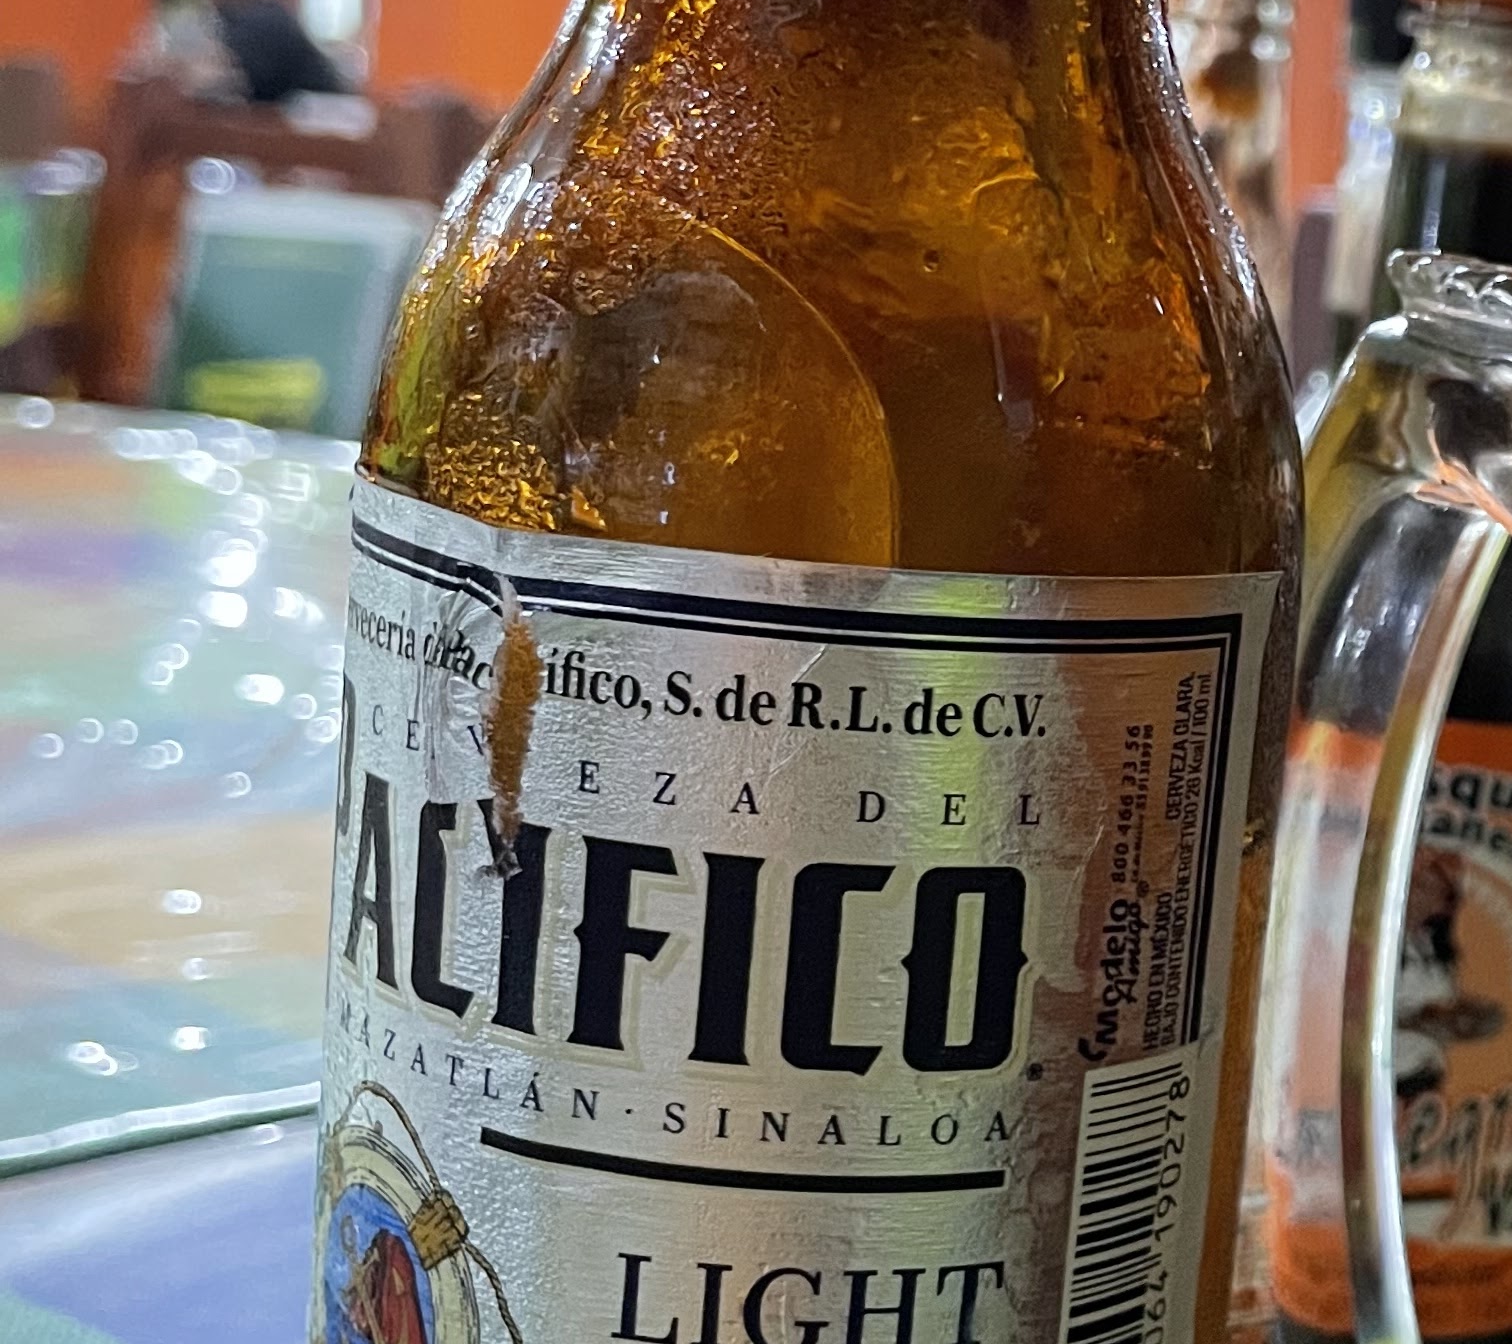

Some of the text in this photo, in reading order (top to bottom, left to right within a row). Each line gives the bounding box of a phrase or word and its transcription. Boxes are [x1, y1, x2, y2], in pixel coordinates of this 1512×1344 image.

[348, 598, 416, 662] vecería
[664, 670, 701, 717] S.
[715, 674, 776, 725] de
[903, 687, 963, 736] de
[973, 692, 1047, 739] C.V.
[1193, 699, 1210, 725] 100
[371, 704, 1041, 826] CEVEZA DEL
[1165, 739, 1188, 821] CERVEZA
[1188, 739, 1205, 774] Kcal
[1111, 725, 1141, 883] 800 466 33 56
[1174, 801, 1199, 903] ENERGÉTICO
[1150, 892, 1173, 958] MÉXICO
[1165, 906, 1188, 1002] CONTENIDO
[1095, 899, 1149, 1045] Modelo Amigo
[1149, 961, 1166, 988] EN
[1142, 990, 1164, 1050] HECHO
[1160, 1003, 1180, 1047] BAJO
